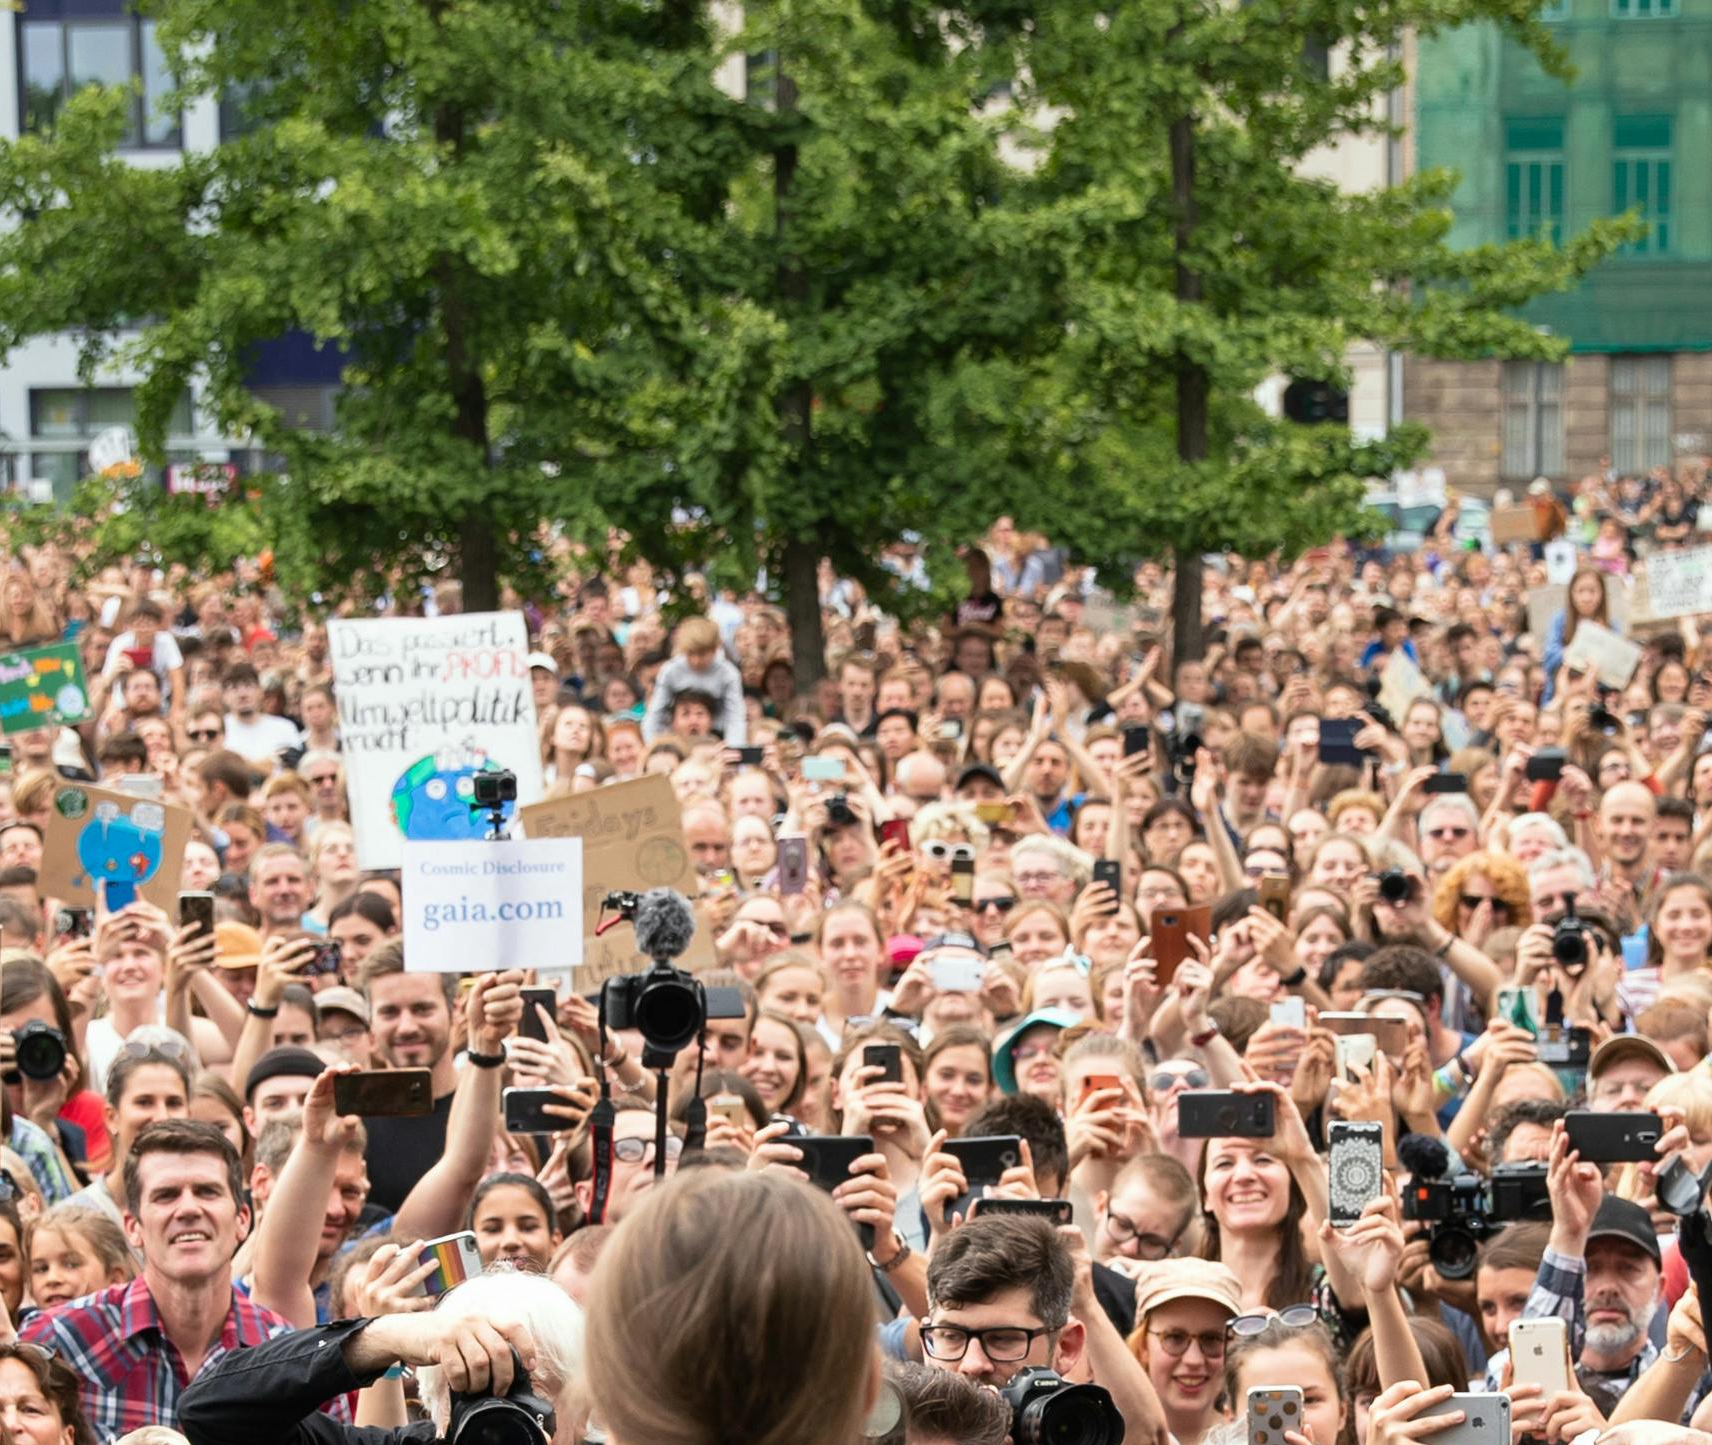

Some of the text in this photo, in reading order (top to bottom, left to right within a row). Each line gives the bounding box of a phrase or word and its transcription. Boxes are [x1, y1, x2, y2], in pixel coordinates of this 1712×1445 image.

[340, 685, 529, 733] Umweltpolitik
[420, 858, 566, 877] Cosmic Disclosure
[422, 895, 564, 932] gaia.com
[1033, 1379, 1059, 1388] Canon
